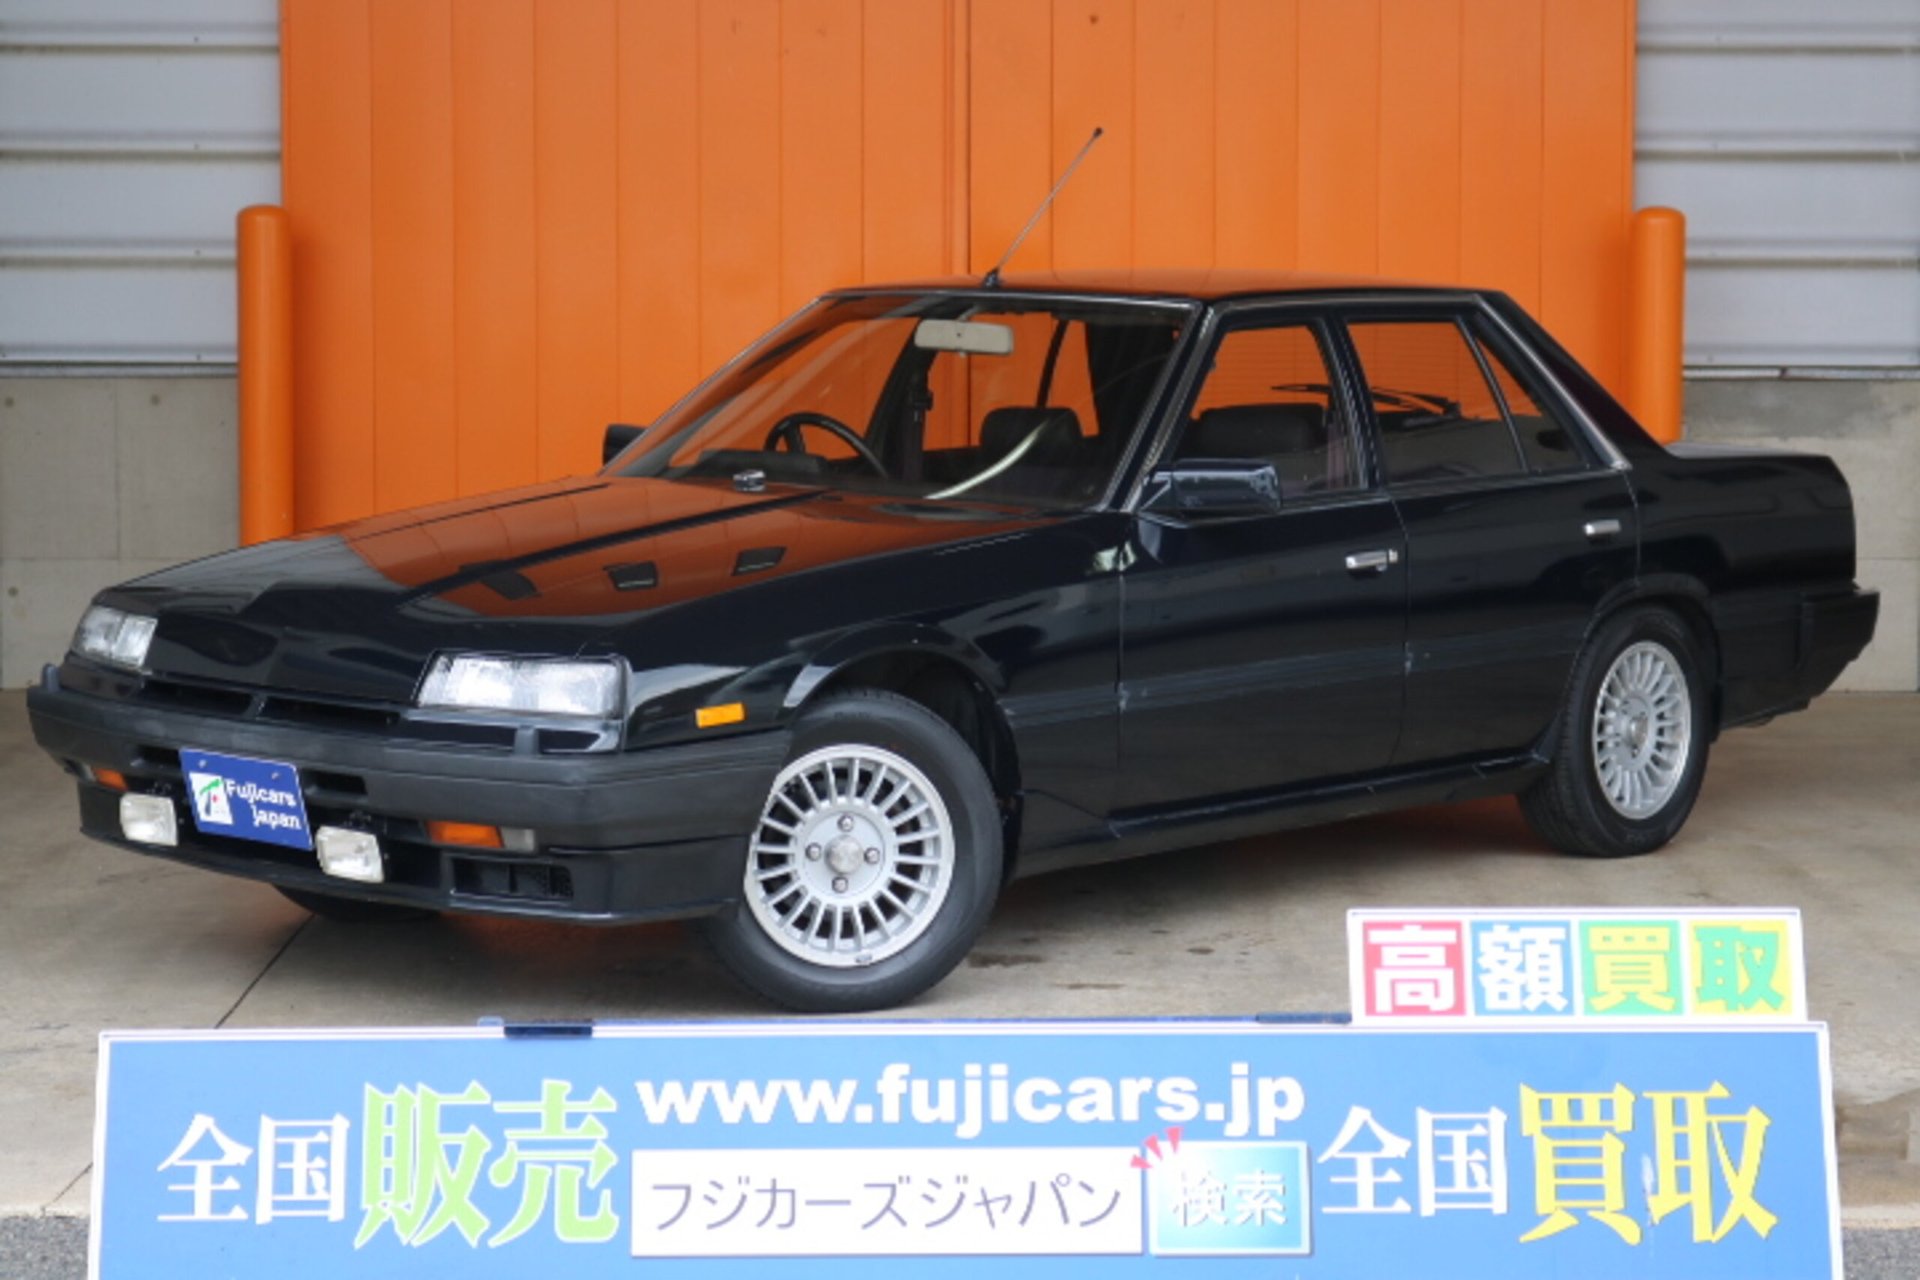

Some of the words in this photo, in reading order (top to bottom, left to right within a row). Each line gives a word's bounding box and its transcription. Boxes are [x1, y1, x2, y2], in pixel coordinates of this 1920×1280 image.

[225, 779, 297, 807] Fujicars
[1368, 924, 1785, 1013] 高額買取
[635, 1062, 1305, 1138] www.fujicars.jp
[651, 1172, 1121, 1231] フジカーズジャパン
[1171, 1168, 1288, 1228] 検索
